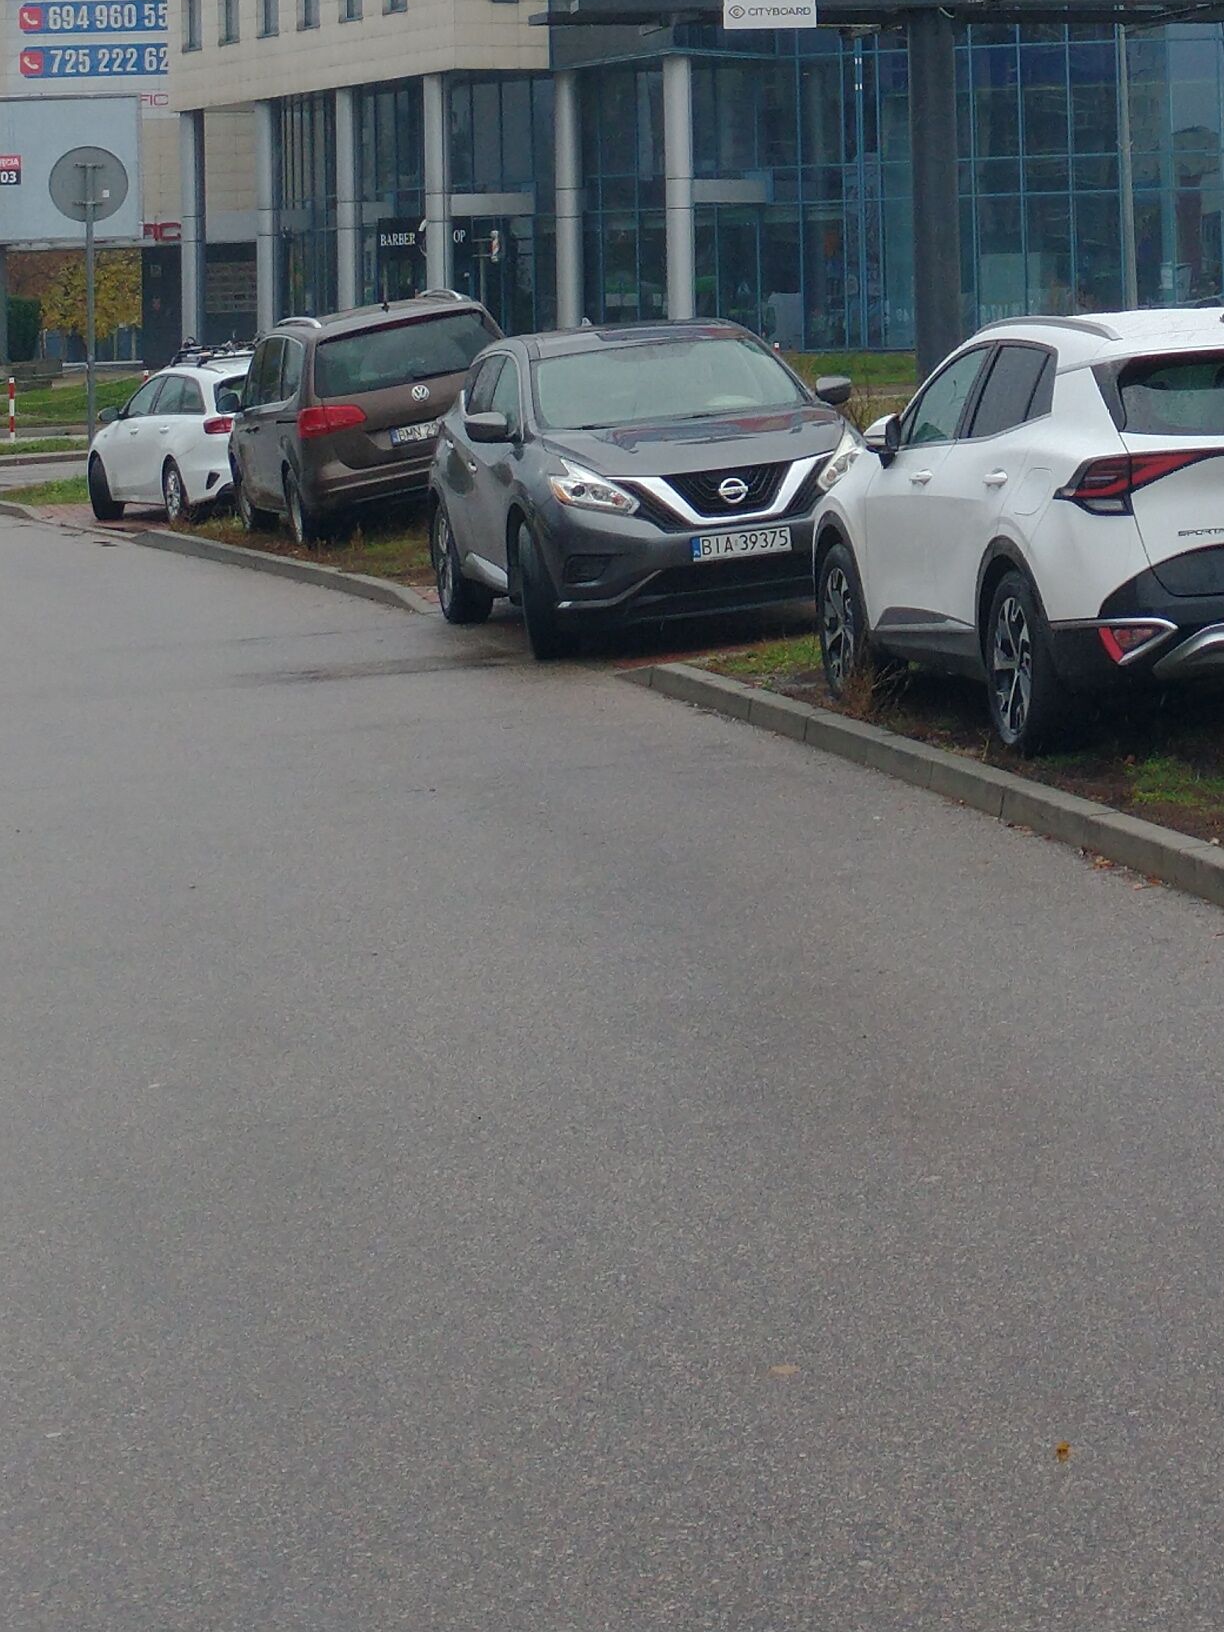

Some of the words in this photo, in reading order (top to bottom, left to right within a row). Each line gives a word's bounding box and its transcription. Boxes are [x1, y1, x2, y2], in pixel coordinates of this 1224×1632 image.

[48, 4, 90, 30] 694
[95, 4, 137, 29] 960
[144, 3, 168, 28] 55
[748, 7, 811, 16] CITYBOARD
[50, 49, 91, 74] 725
[98, 48, 138, 72] 222
[144, 47, 168, 71] 62
[380, 232, 416, 247] BARBER
[453, 229, 466, 243] OP
[702, 536, 734, 555] BIA
[739, 529, 788, 551] 39375
